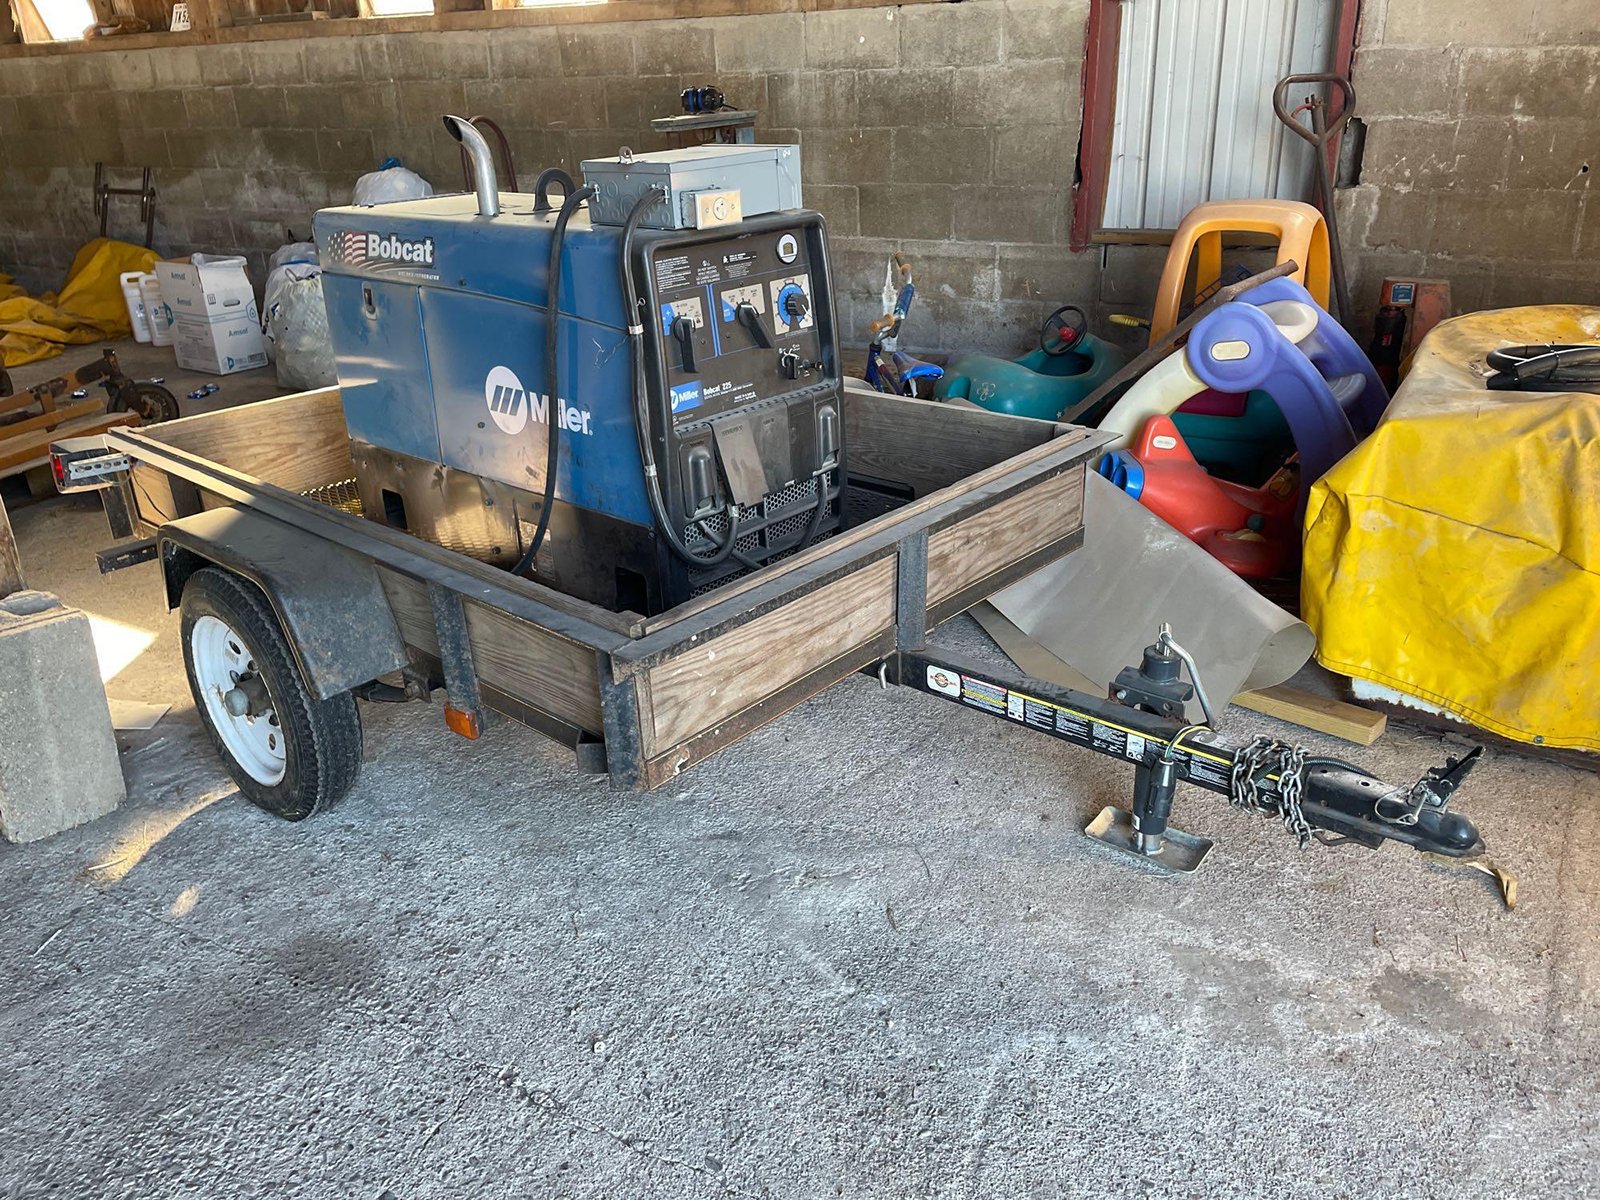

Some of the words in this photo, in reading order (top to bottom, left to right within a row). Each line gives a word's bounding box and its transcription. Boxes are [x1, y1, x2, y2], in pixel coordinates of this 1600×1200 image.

[368, 233, 433, 263] Bobcat
[678, 390, 699, 402] Miller
[703, 384, 721, 396] Bobcat
[529, 391, 591, 435] Mller
